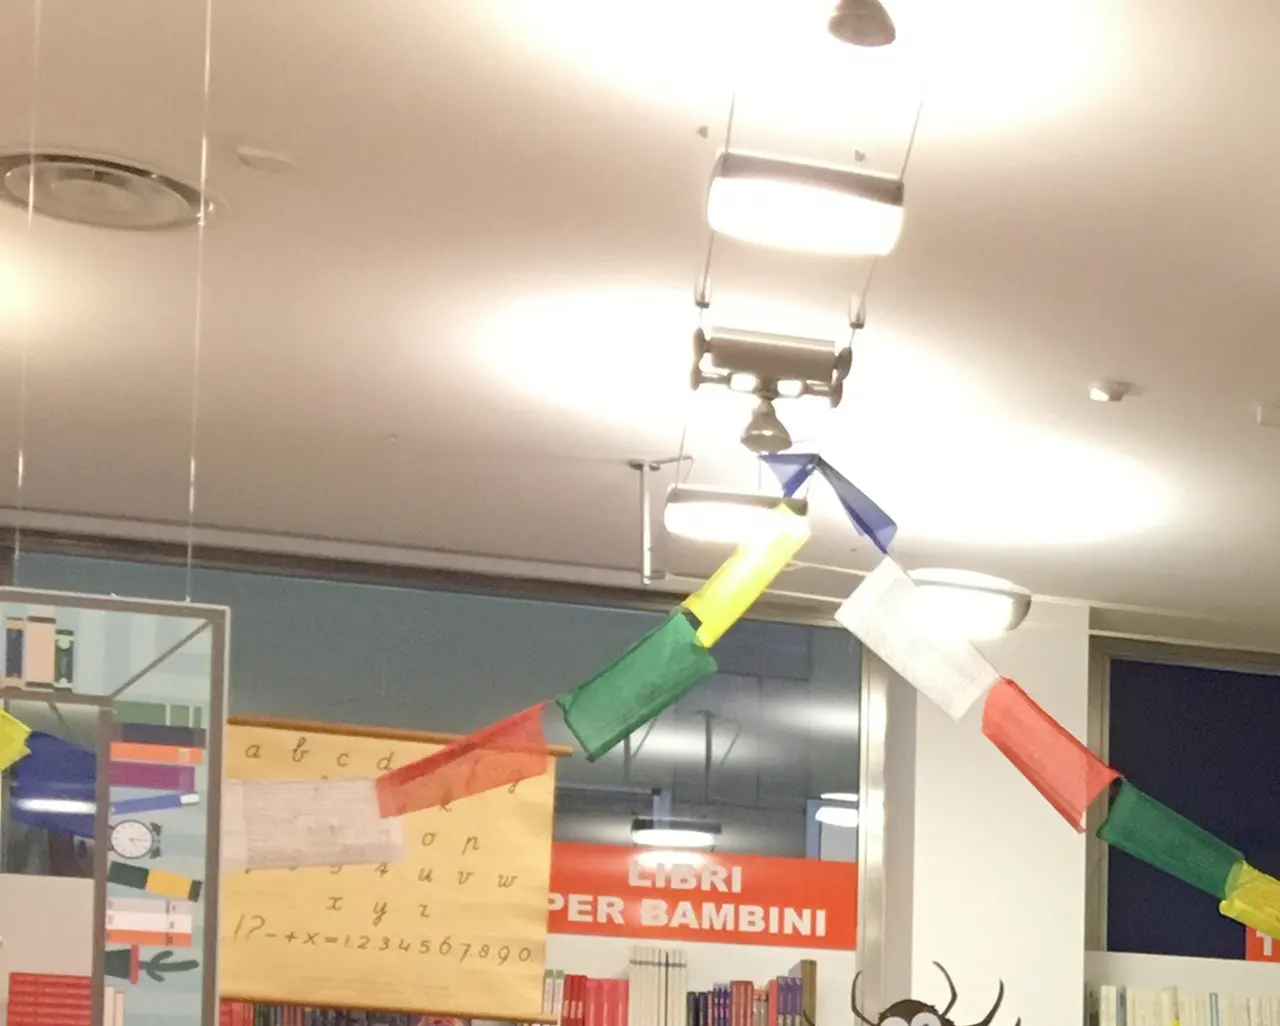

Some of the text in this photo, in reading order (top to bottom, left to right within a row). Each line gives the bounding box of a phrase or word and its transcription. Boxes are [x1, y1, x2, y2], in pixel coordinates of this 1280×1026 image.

[245, 737, 394, 771] a b c d
[421, 832, 437, 847] o
[418, 867, 434, 883] u
[497, 873, 519, 889] w
[628, 860, 743, 893] LIBRI
[372, 901, 388, 927] y
[548, 891, 826, 937] PER BAMBINI
